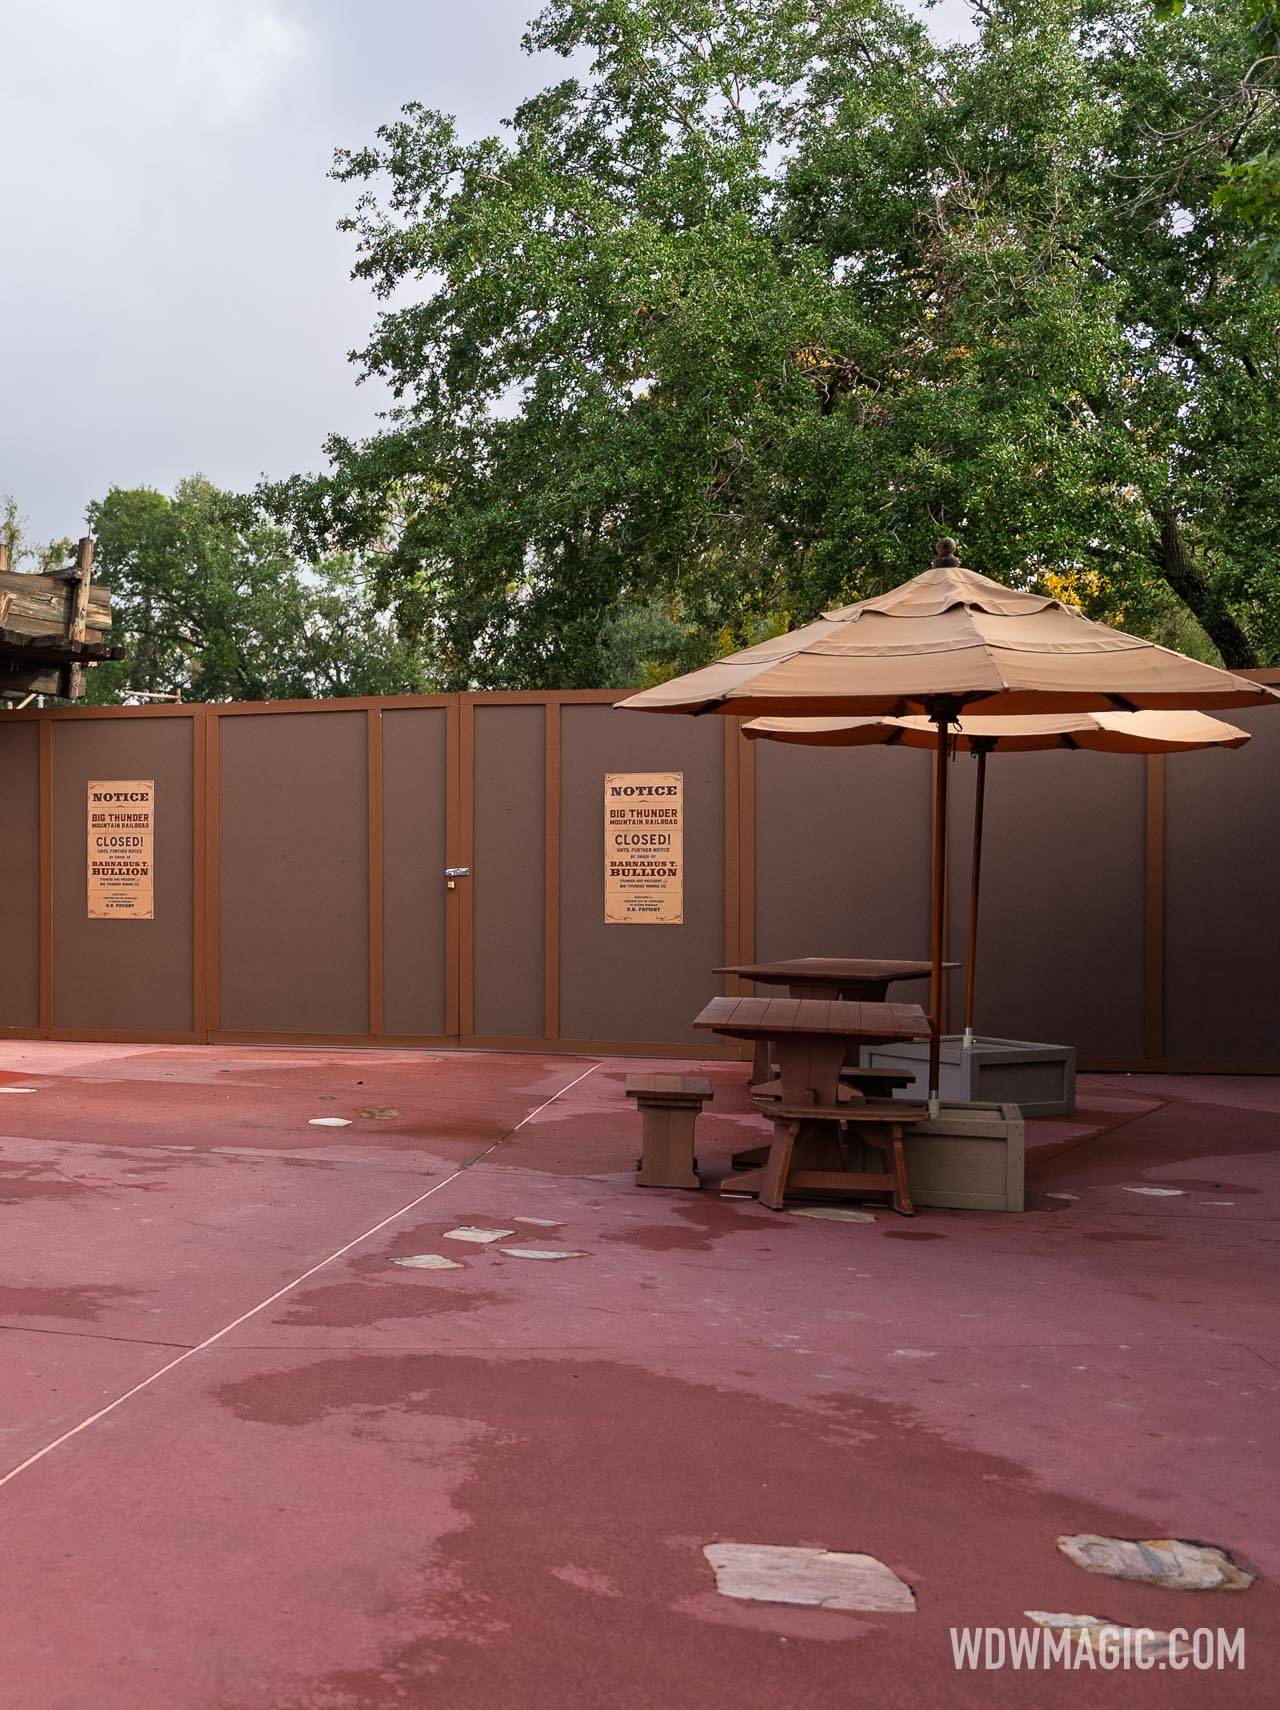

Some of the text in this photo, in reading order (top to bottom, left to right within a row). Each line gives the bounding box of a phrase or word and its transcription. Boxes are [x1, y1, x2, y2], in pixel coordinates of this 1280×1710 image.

[611, 786, 677, 796] NOTICE
[92, 793, 149, 801] NOTICE
[610, 809, 678, 818] BIG THUNDER
[96, 837, 143, 847] CLOSED!
[615, 834, 670, 845] CLOSED!
[610, 868, 678, 876] BULLION
